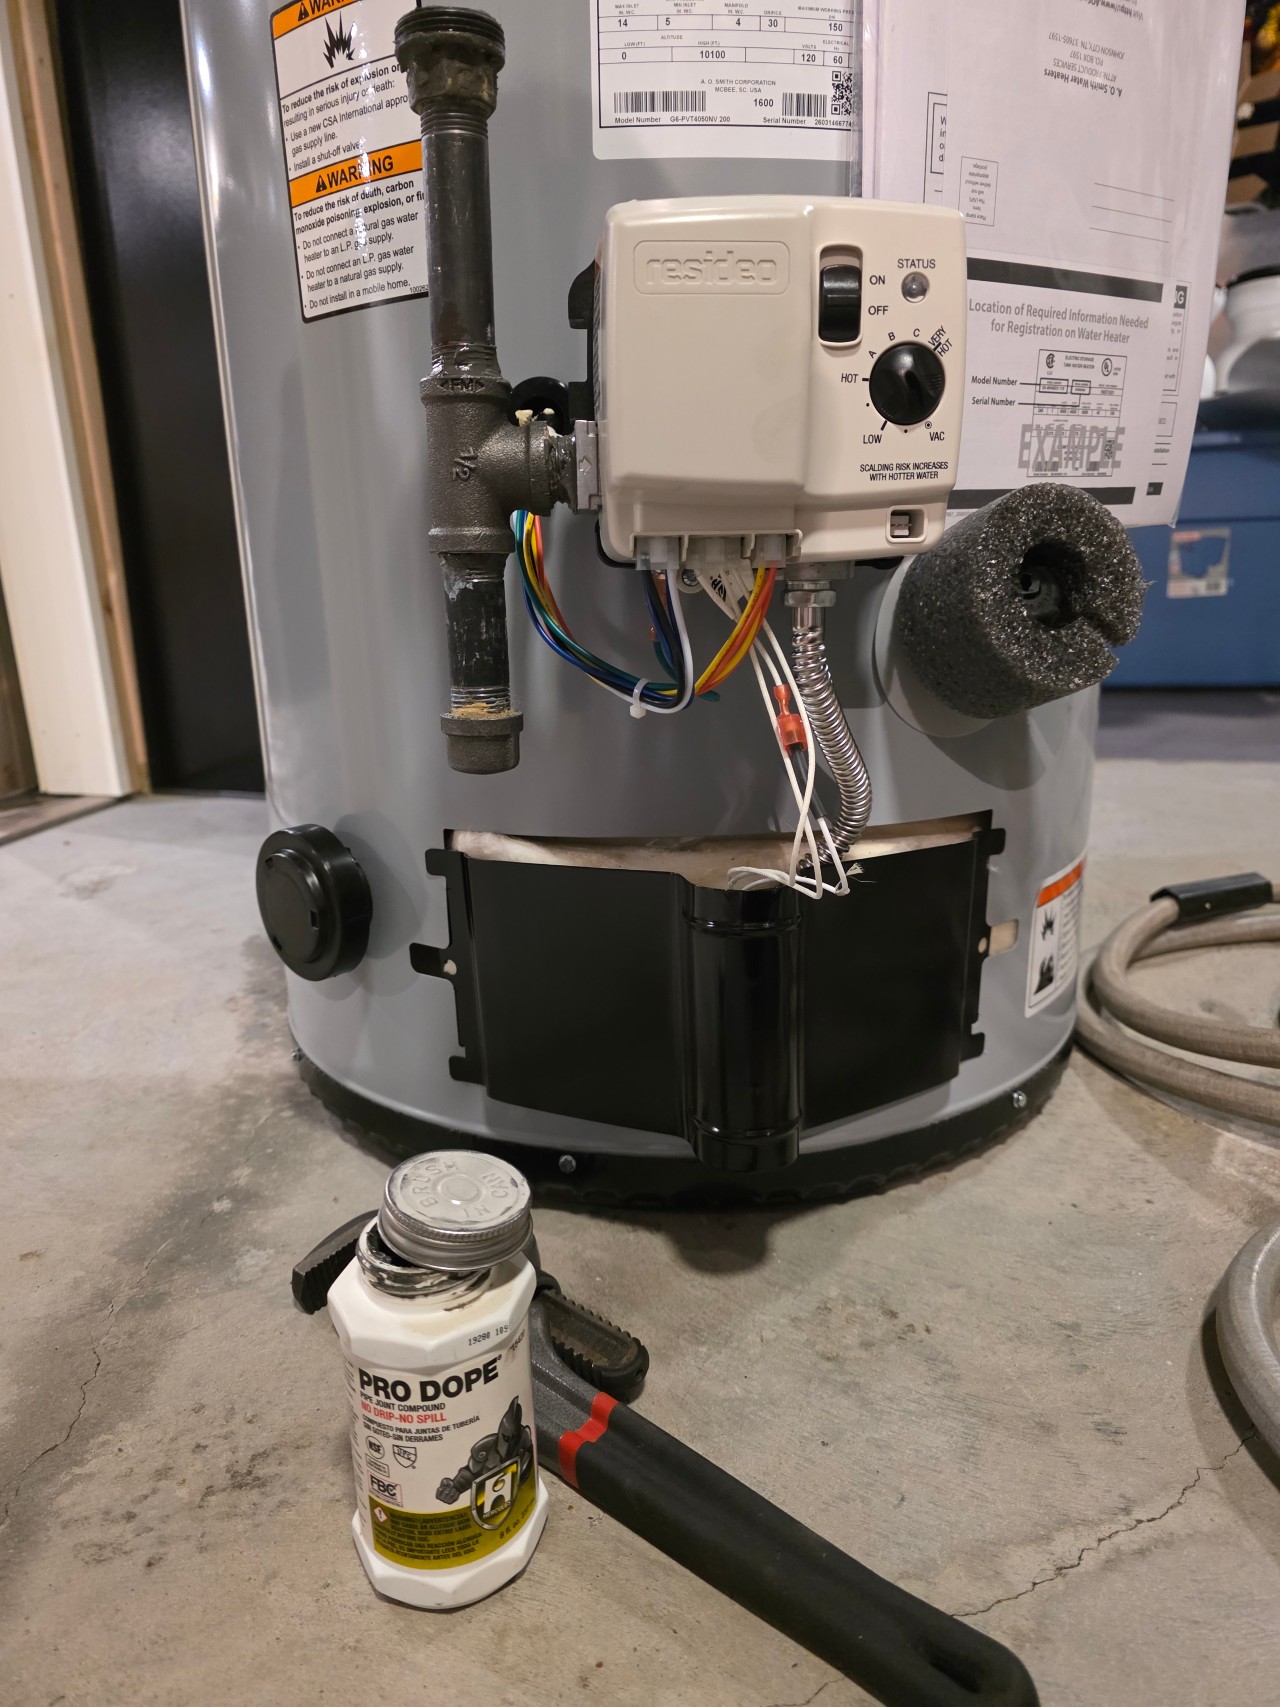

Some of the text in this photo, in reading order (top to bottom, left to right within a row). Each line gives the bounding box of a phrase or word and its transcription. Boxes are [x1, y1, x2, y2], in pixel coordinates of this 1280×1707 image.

[618, 19, 628, 27] 14
[736, 18, 740, 26] 4
[768, 19, 778, 27] 30
[829, 23, 842, 32] 150
[1049, 32, 1079, 46] 37605-1597
[1081, 41, 1088, 49] TN
[622, 52, 626, 60] 0
[802, 54, 816, 62] 120
[833, 56, 842, 64] 60
[1070, 50, 1082, 60] 1597
[1084, 53, 1094, 64] BOX
[1101, 47, 1125, 60] JOHNSON
[1044, 69, 1069, 83] Heaters
[1053, 58, 1117, 82] ATTN: PRODUCT SERVICES
[1070, 76, 1089, 88] Water
[1090, 81, 1108, 94] Smith
[282, 105, 289, 114] To
[291, 96, 312, 110] reduce
[313, 90, 324, 99] the
[326, 83, 339, 95] risk
[341, 79, 348, 88] of
[754, 99, 773, 107] 1600
[284, 92, 359, 127] resulting in serious injury
[291, 102, 384, 141] Use a new CSA International
[292, 132, 338, 157] gas supply line.
[294, 158, 310, 171] Install
[317, 147, 341, 161] shut-off
[294, 212, 302, 221] To
[303, 205, 323, 218] reduce
[325, 200, 335, 210] the
[337, 195, 350, 207] risk
[352, 192, 359, 202] of
[386, 180, 414, 193] carbon
[296, 194, 415, 235] monoxide explosion, or
[303, 240, 311, 250] Do
[312, 236, 322, 246] not
[323, 229, 351, 243] connect
[381, 218, 395, 229] gas
[396, 212, 418, 224] water
[304, 251, 322, 263] heater
[331, 246, 339, 254] an
[340, 241, 352, 251] L.P.
[369, 232, 394, 244] supply.
[306, 245, 414, 280] Do not connect an L.P. gas water
[897, 259, 936, 269] STATUS
[308, 281, 325, 292] heater
[327, 279, 333, 287] to
[340, 269, 362, 283] natural
[364, 267, 376, 279] gas
[378, 261, 404, 275] supply.
[869, 275, 886, 285] ON
[310, 300, 318, 309] Do
[320, 296, 328, 306] not
[330, 291, 347, 302] install
[349, 289, 354, 297] in
[362, 283, 385, 296] mobile
[387, 278, 410, 290] home.
[868, 306, 888, 315] OFF
[968, 298, 1150, 329] Location of Required Information Needed
[888, 332, 896, 341] B
[913, 328, 920, 337] C
[928, 325, 946, 346] VERY
[990, 318, 1130, 344] for Registration on Water Heater
[868, 350, 877, 358] A
[937, 338, 952, 357] HOT
[841, 373, 858, 383] HOT
[971, 376, 1017, 385] Model Number
[972, 397, 1015, 406] Serial Number
[863, 434, 882, 444] LOW
[929, 431, 945, 441] VAC
[1018, 423, 1126, 470] EXAMPLE
[860, 463, 894, 472] SCALDING
[913, 462, 949, 470] INCREASES
[870, 471, 939, 481] WITH HOTTER WATER
[412, 1160, 460, 1207] BRUSH
[463, 1203, 491, 1218] IN
[469, 1331, 490, 1346] 19280
[358, 1367, 412, 1402] PRO
[360, 1390, 446, 1412] PIPE JOINT COMPOUND
[361, 1402, 447, 1424] NO DRIP-NO SPILL
[362, 1414, 394, 1432] COMPUESTO
[441, 1424, 451, 1432] DE
[452, 1415, 480, 1429] TUBERÍA
[363, 1421, 372, 1431] SIN
[404, 1434, 444, 1442] DERRAMES
[370, 1474, 396, 1496] FBC
